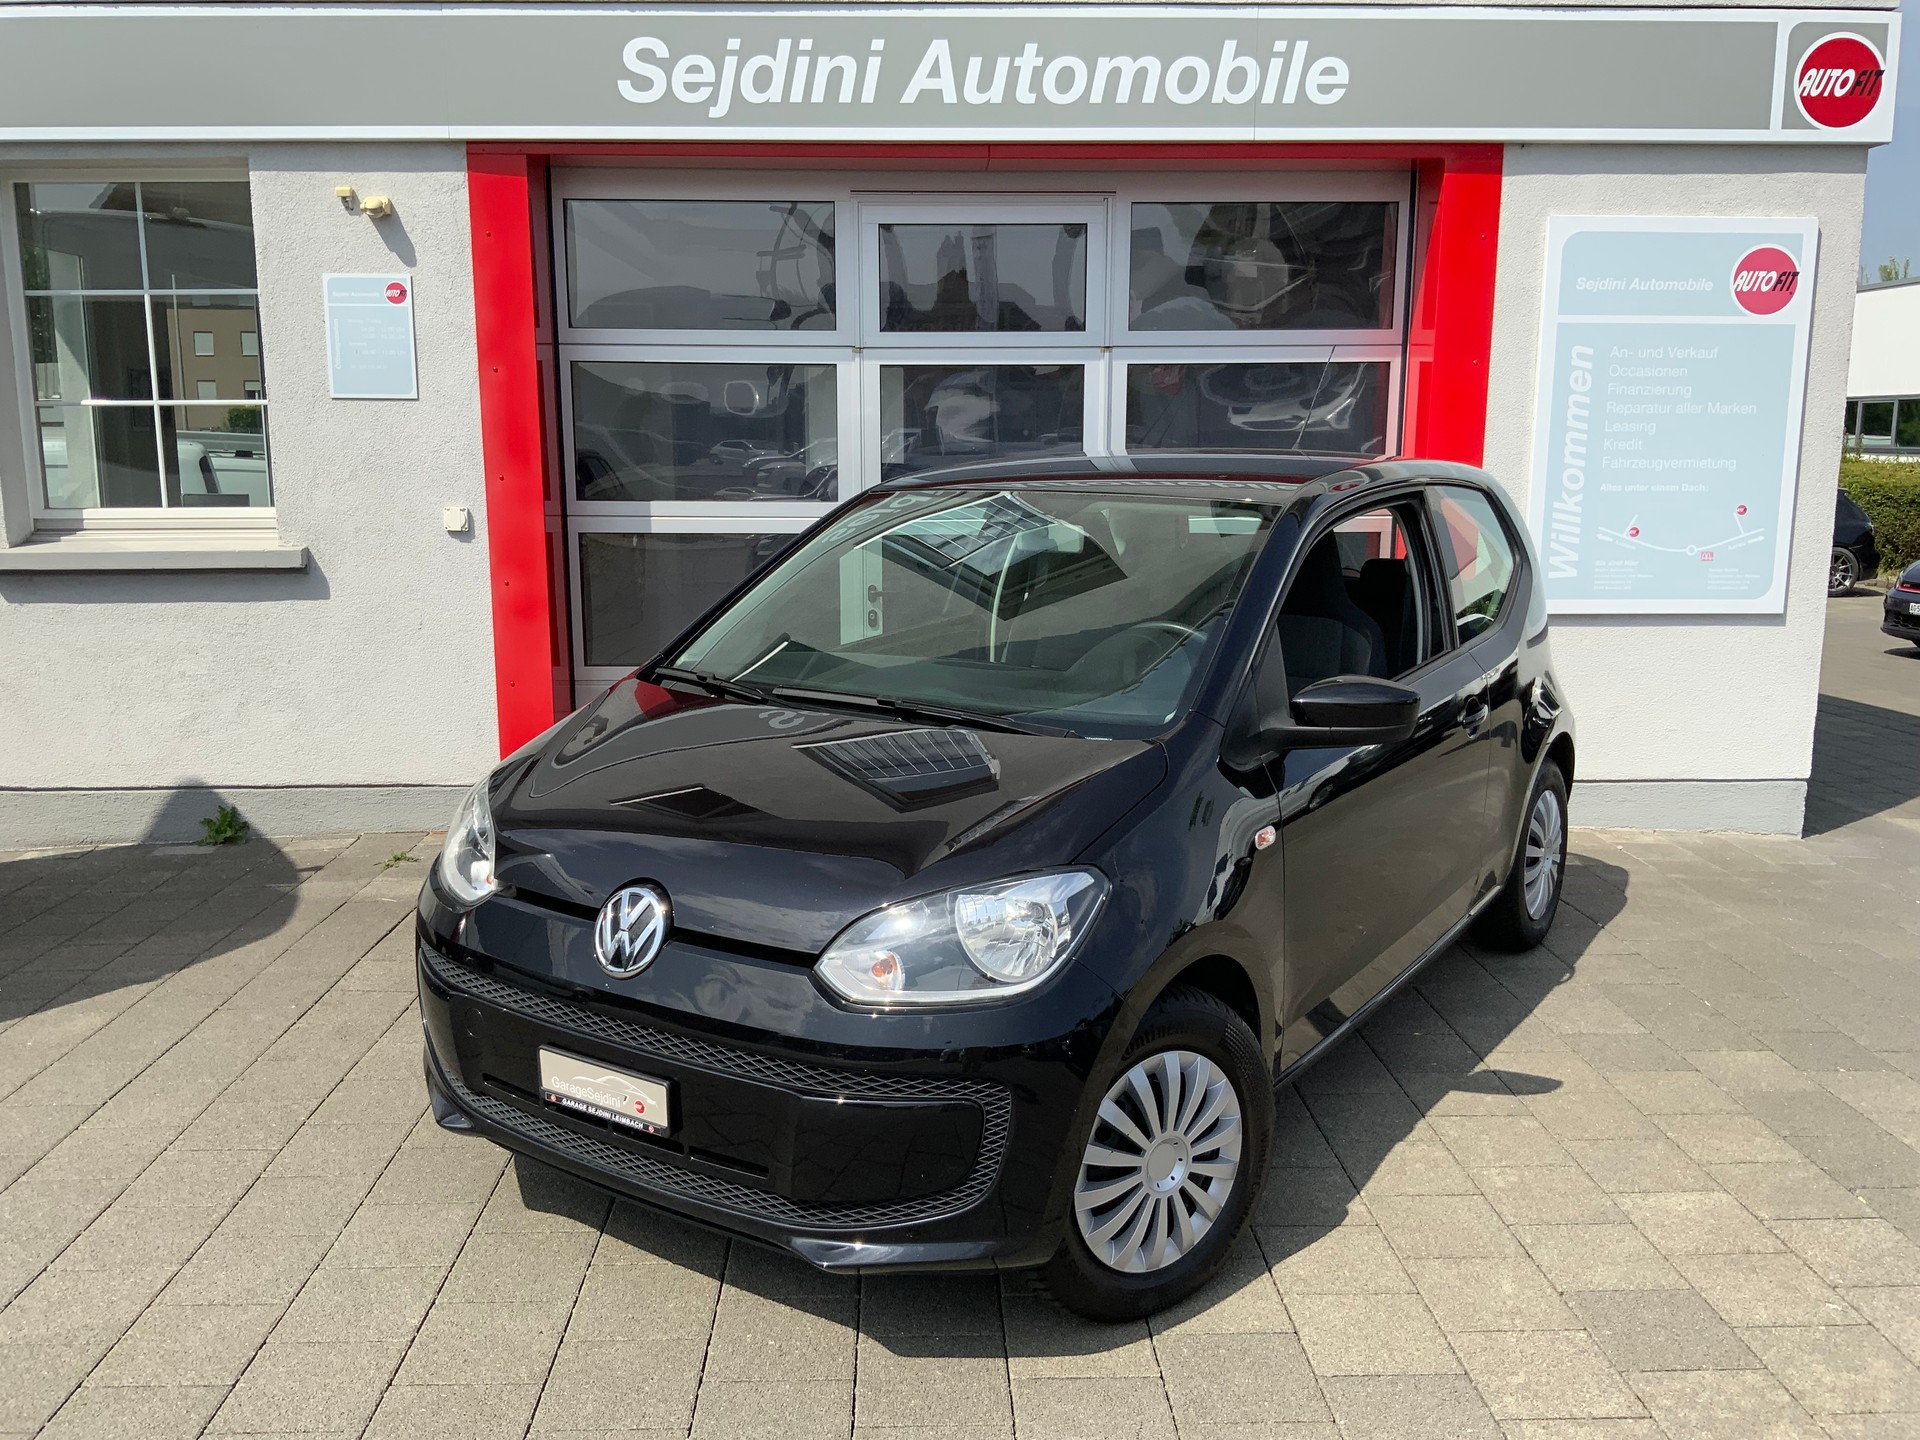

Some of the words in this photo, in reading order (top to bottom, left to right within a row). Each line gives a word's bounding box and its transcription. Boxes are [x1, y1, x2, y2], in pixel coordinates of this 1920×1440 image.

[617, 36, 886, 118] Sejdini
[900, 39, 1350, 105] Automobile
[1575, 276, 1627, 294] Sejdini
[1629, 278, 1714, 292] Automobile
[1610, 345, 1634, 359] An-
[1638, 346, 1663, 359] und
[1668, 346, 1719, 359] Verkauf
[1609, 364, 1688, 377] Occasionen
[1607, 383, 1692, 398] Finanzierung
[1606, 401, 1673, 416] Reparatur
[1675, 402, 1704, 415] aller
[1708, 402, 1757, 415] Marken
[1604, 420, 1657, 435] Leasing
[1603, 438, 1642, 450] Kredit
[1547, 345, 1594, 579] Willkommen
[1601, 456, 1737, 472] Fahrzeugvermietung
[561, 1098, 587, 1111] GARAGE
[588, 1105, 612, 1120] SEJDINI
[612, 1112, 643, 1130] LEIMBACH
